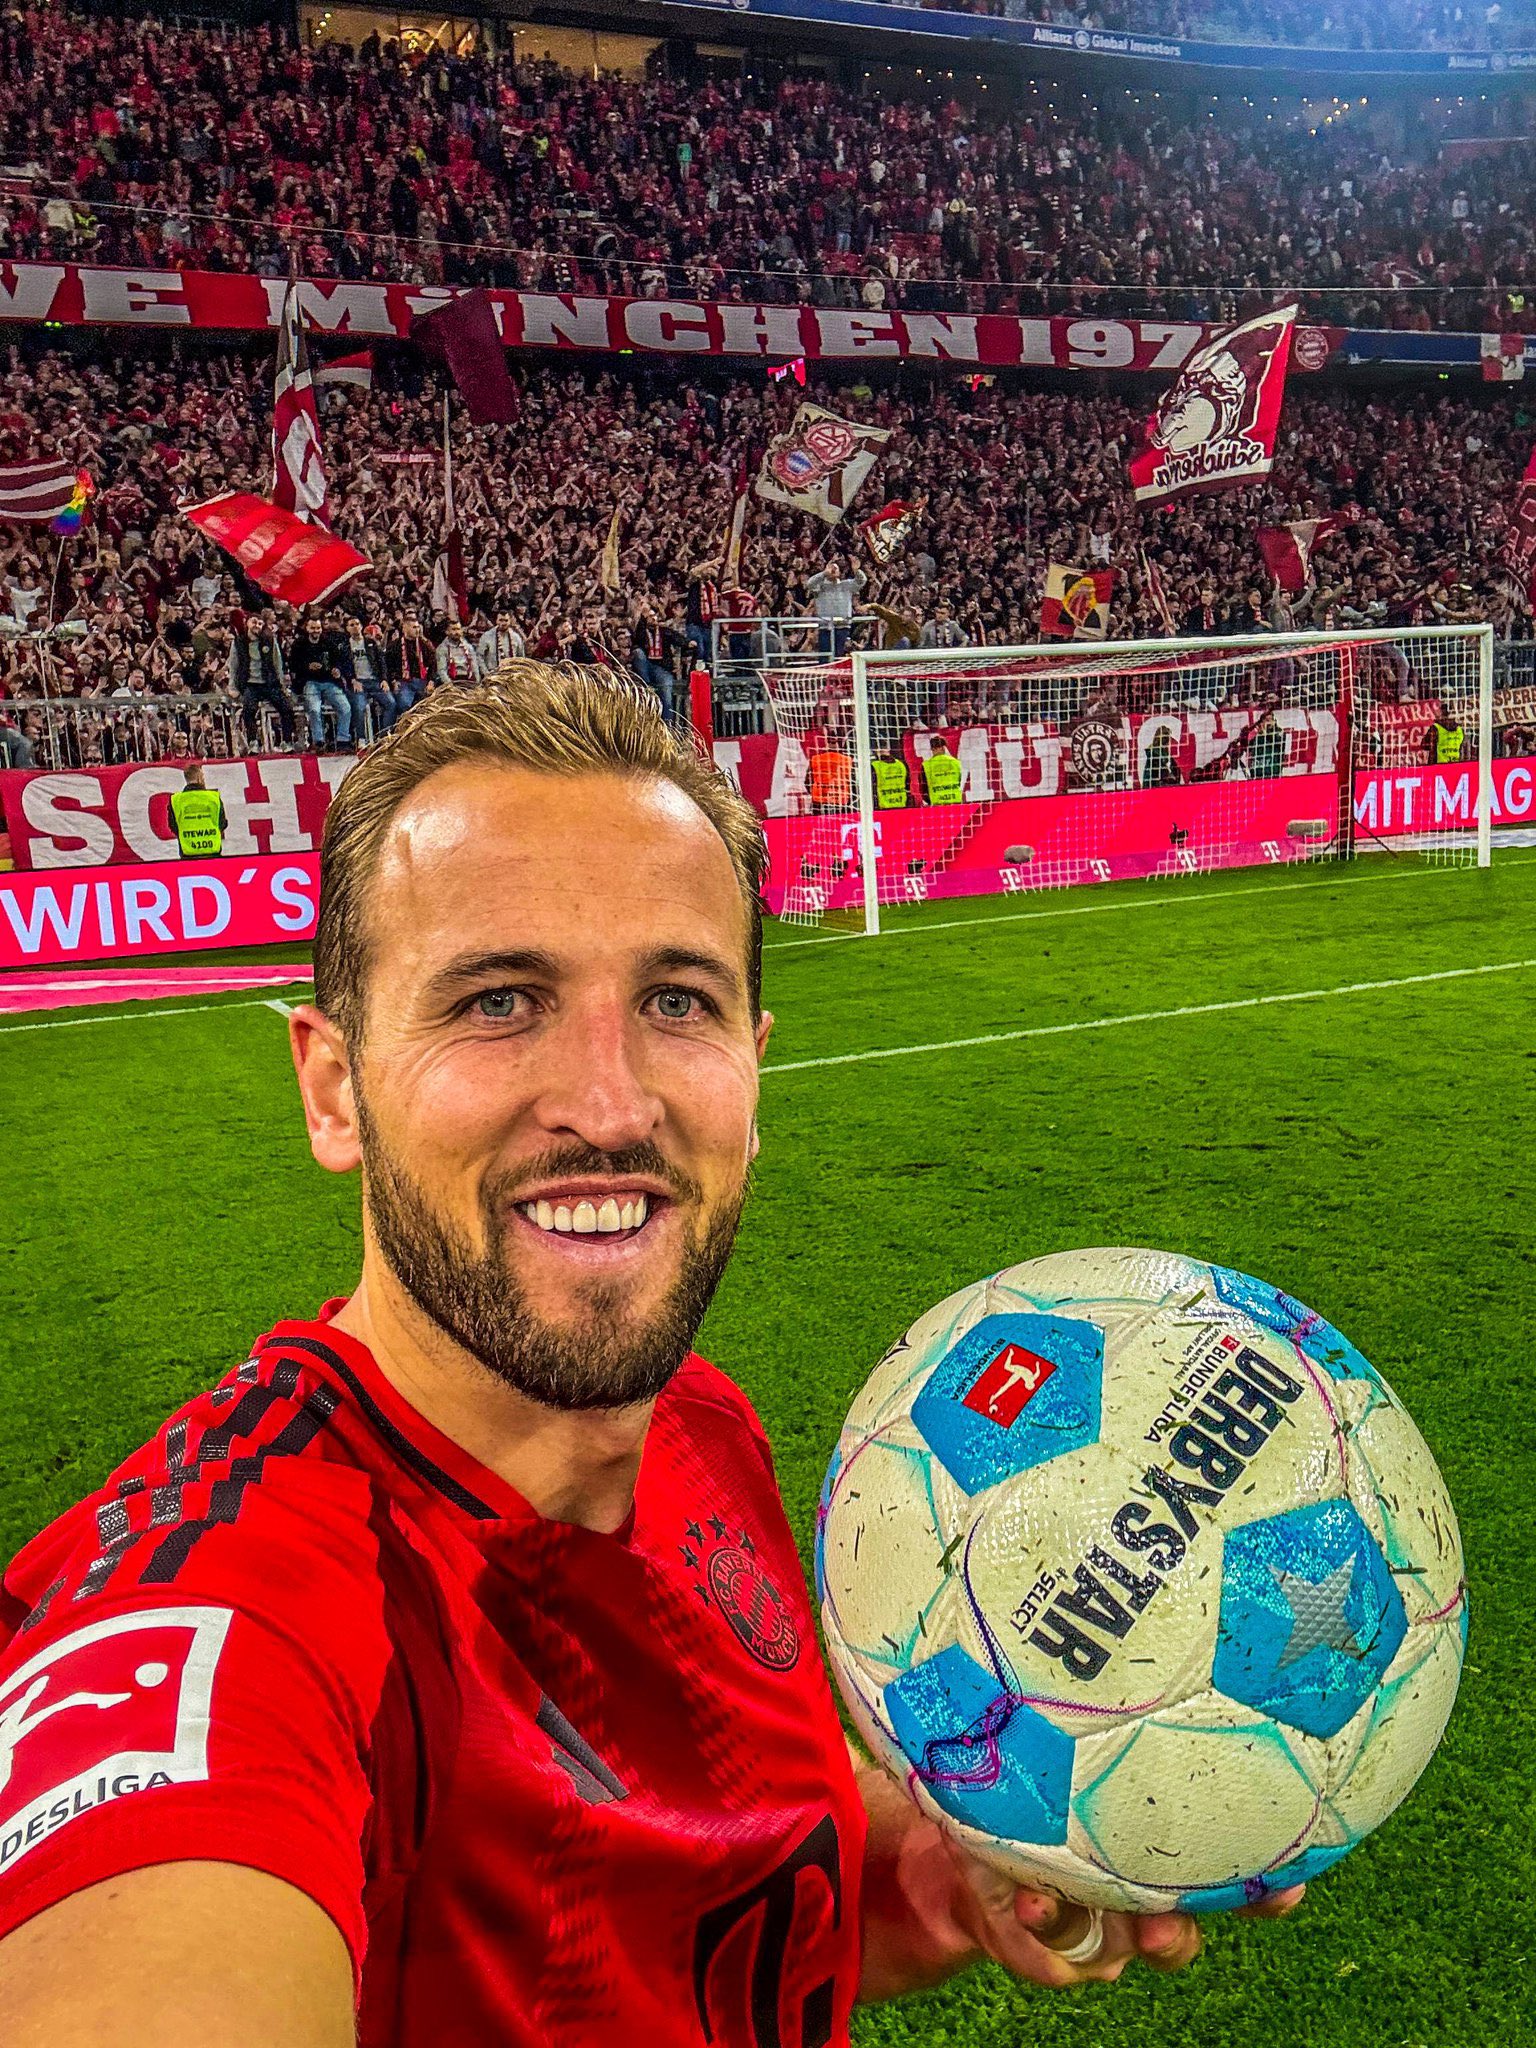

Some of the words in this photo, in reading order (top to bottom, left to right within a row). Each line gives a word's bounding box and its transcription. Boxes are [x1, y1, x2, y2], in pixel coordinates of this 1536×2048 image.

[1033, 28, 1073, 45] Allianz
[1092, 35, 1128, 50] Global
[1130, 39, 1181, 57] Investors
[1018, 319, 1226, 369] 197
[182, 828, 217, 839] STEWARD
[950, 1338, 1006, 1401] BUNDESLIGA
[1144, 1346, 1229, 1443] BUNDESLIGA
[1028, 1346, 1305, 1682] DERBYSTAR
[1009, 1571, 1057, 1634] SELECT
